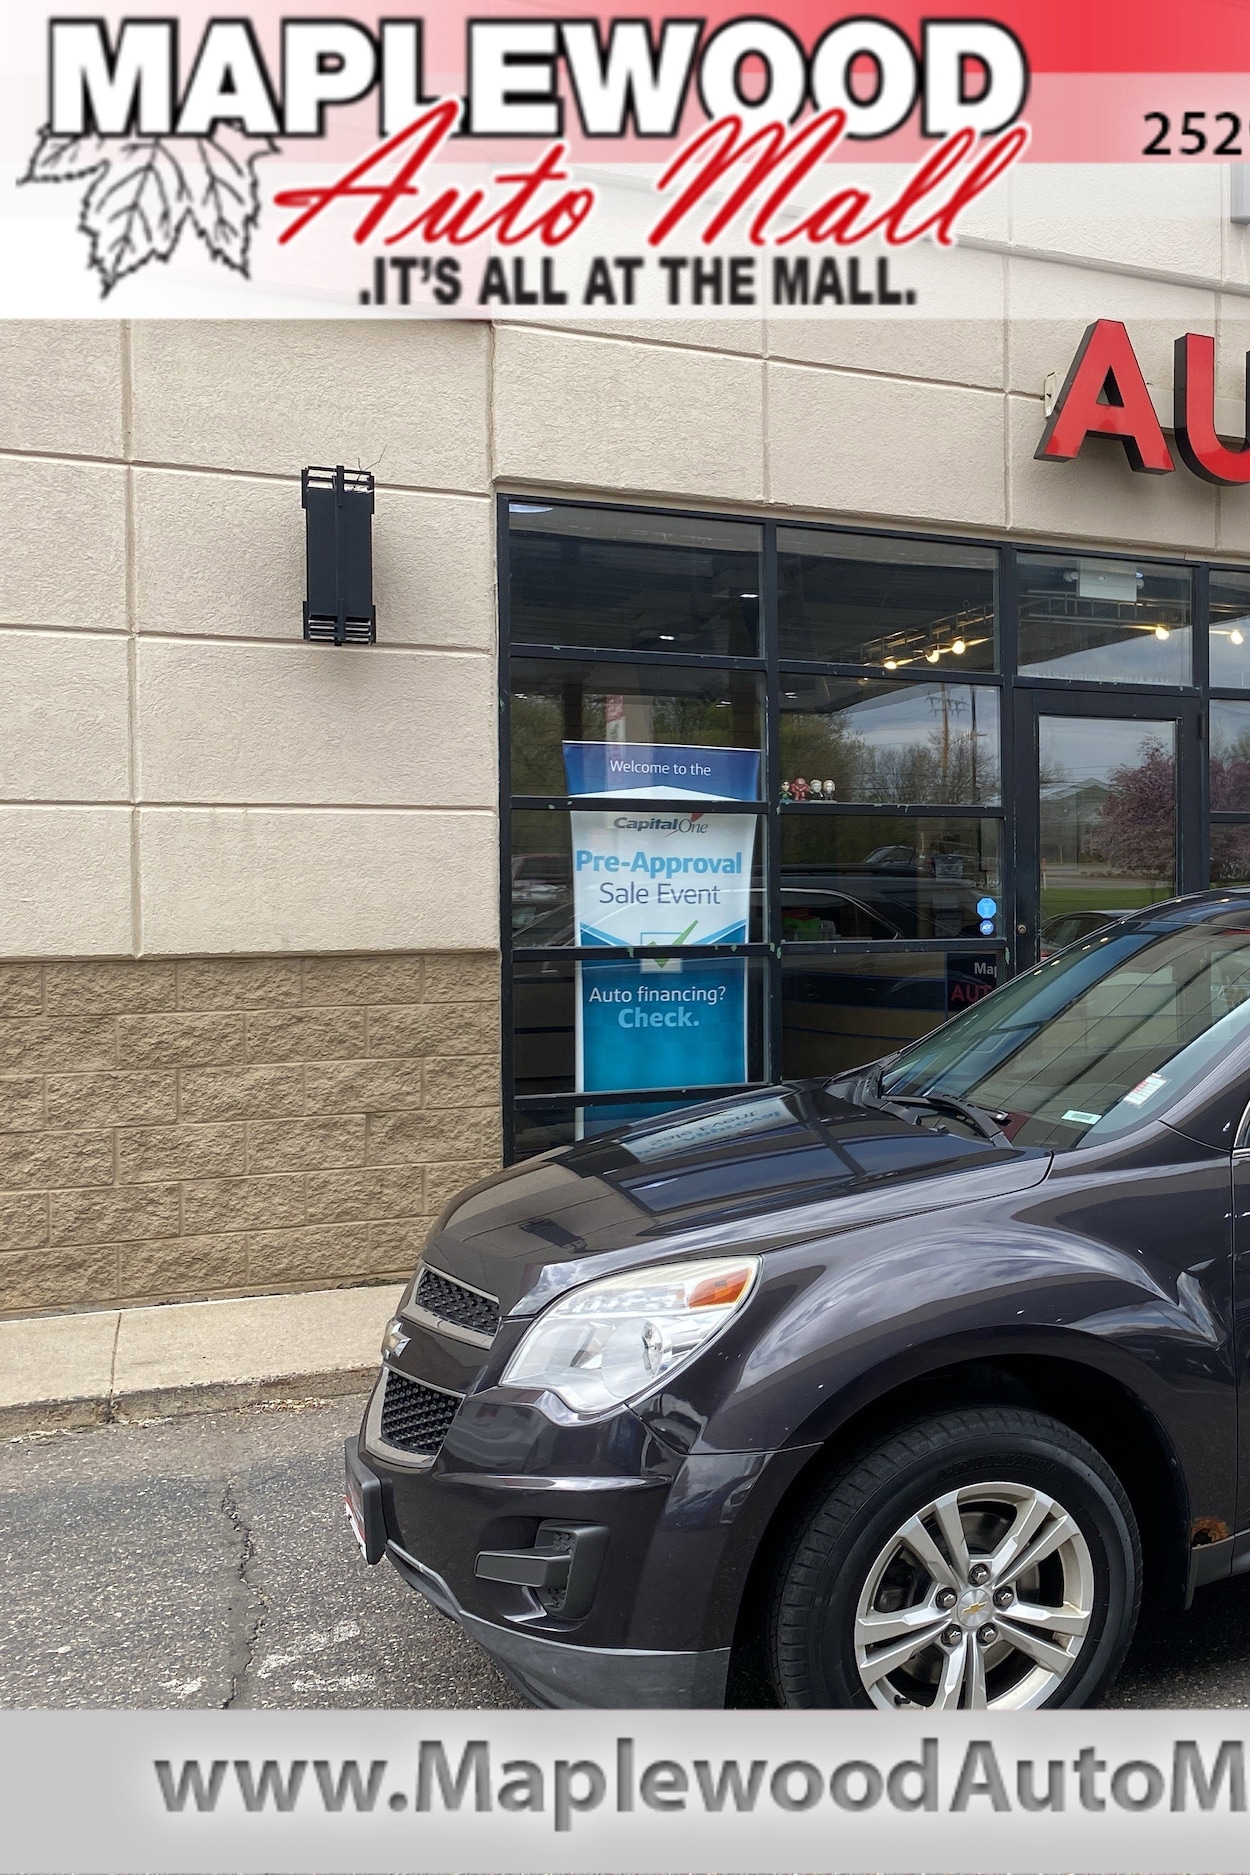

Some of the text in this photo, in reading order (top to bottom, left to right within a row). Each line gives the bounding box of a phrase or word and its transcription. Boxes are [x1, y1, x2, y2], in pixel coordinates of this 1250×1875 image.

[610, 759, 712, 777] Welcome to the
[575, 849, 743, 880] Pre-Approval
[600, 881, 722, 905] Sale Event
[589, 985, 727, 1006] Auto financing?
[617, 1006, 700, 1029] Check.
